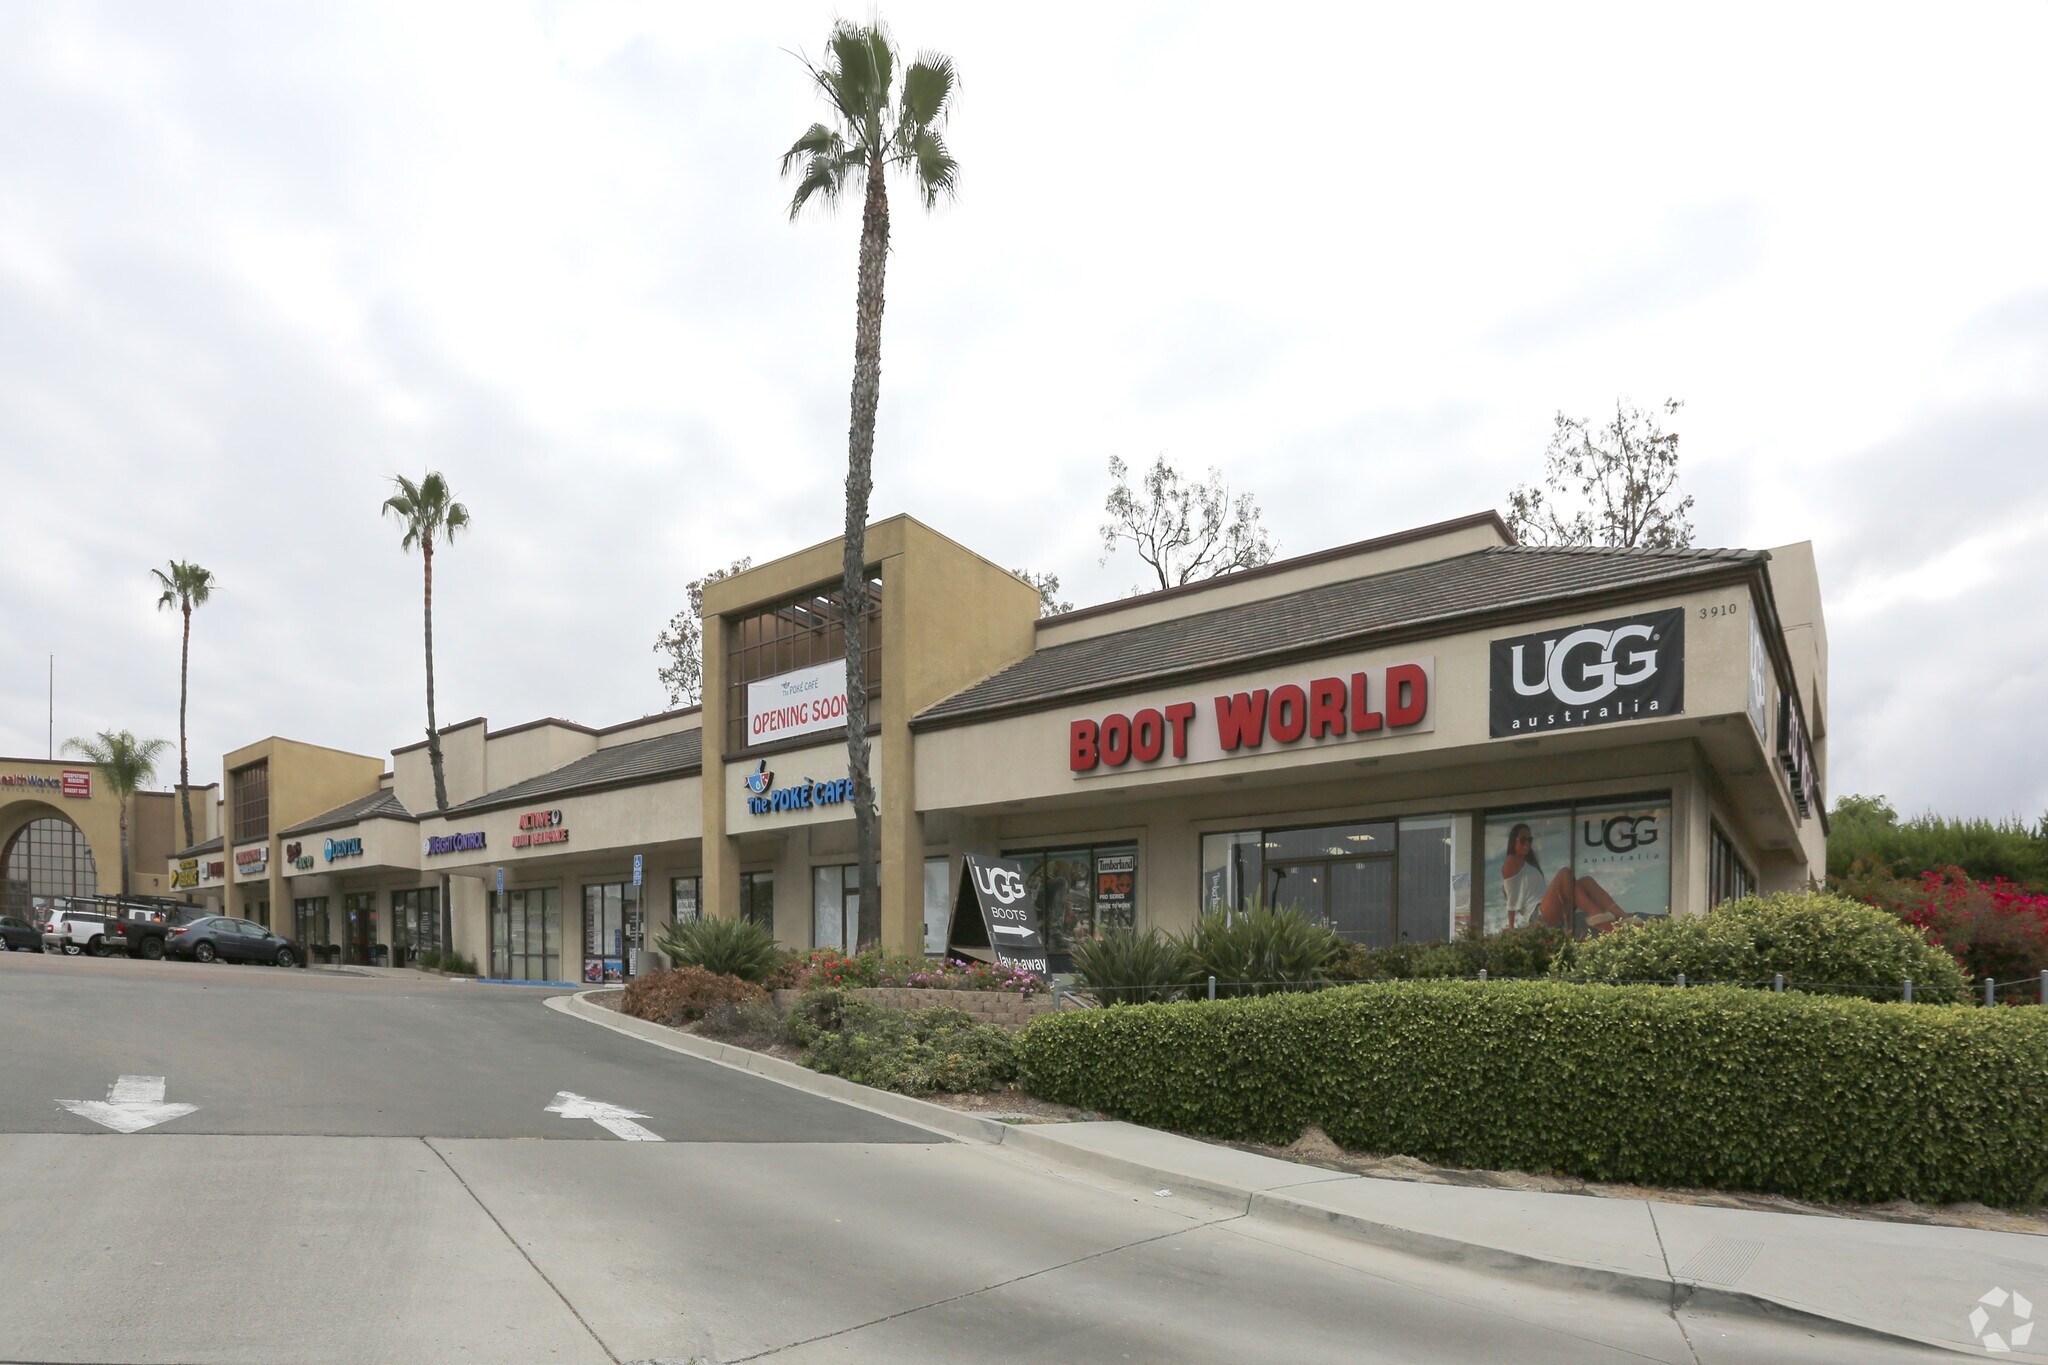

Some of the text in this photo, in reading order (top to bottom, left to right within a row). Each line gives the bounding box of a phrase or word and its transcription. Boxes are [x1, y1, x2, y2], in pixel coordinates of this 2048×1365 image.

[1699, 603, 1737, 620] 3910
[1511, 625, 1658, 705] UGG
[753, 693, 849, 735] OPENING SOON
[1070, 663, 1427, 772] BOOT WORLD
[1512, 699, 1659, 729] australia
[0, 774, 61, 788] ealthWorks
[747, 796, 770, 815] The
[518, 809, 552, 830] ACTIVE
[429, 831, 486, 855] WEIGHT CONTROL
[1584, 815, 1658, 853] UGG
[331, 837, 363, 858] DENTAL
[1099, 857, 1133, 871] Timberland
[1584, 854, 1659, 864] australia
[974, 865, 1026, 904] UGG
[991, 906, 1027, 921] BOOTS
